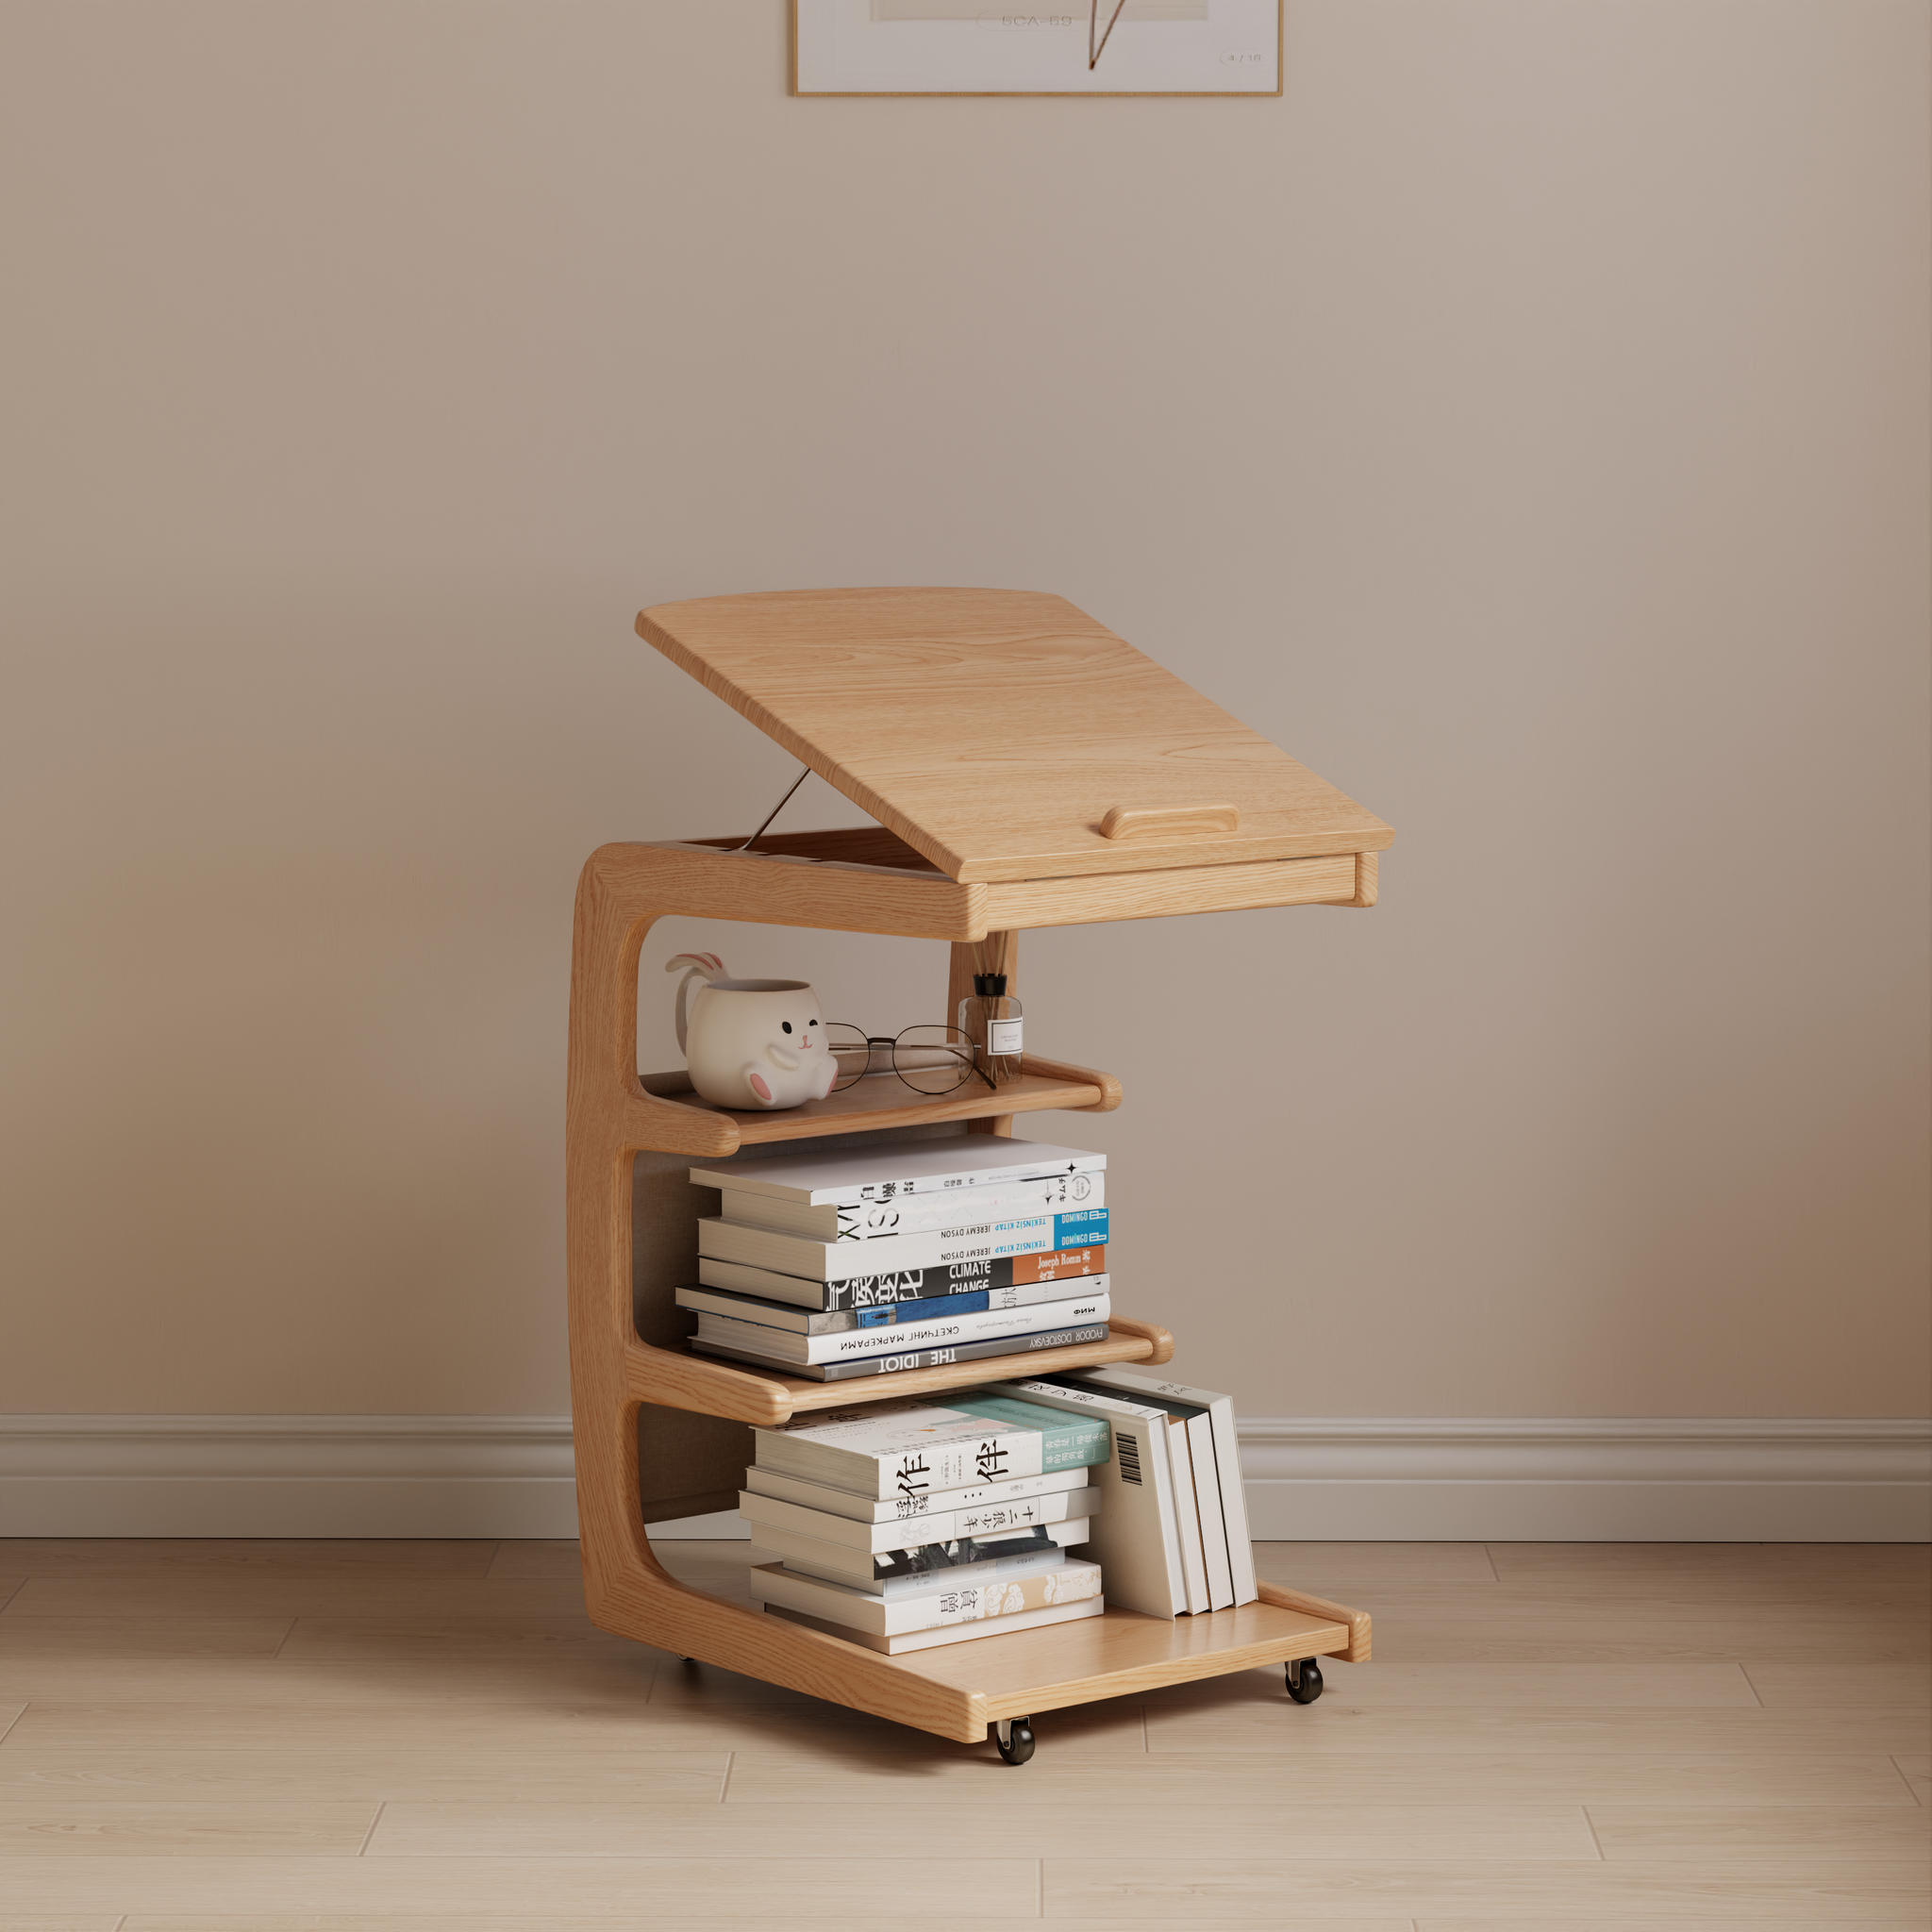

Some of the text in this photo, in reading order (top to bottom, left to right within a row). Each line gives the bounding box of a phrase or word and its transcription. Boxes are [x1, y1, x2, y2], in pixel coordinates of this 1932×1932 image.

[1058, 1176, 1067, 1203] キムチ
[941, 1224, 991, 1239] JEREMY DYSON
[941, 1246, 991, 1261] JEREMY DYSON
[994, 1240, 1047, 1255] TEKİNSİZ KİTAP
[949, 1260, 991, 1279] CLIMATE
[1038, 1254, 1059, 1270] Joseph
[1060, 1253, 1082, 1264] Romm
[1074, 1307, 1096, 1316] МИФ
[841, 1325, 959, 1350] СКЕТЧИНГ МАРКЕРАМИ
[1029, 1327, 1104, 1348] FYODOR DOSTOEVSKY
[877, 1348, 957, 1374] THE IDIOT
[896, 1454, 930, 1497] 作
[976, 1439, 1009, 1483] 伴
[963, 1506, 1034, 1532] 十二狼少年
[940, 1588, 979, 1613] 貧僧
